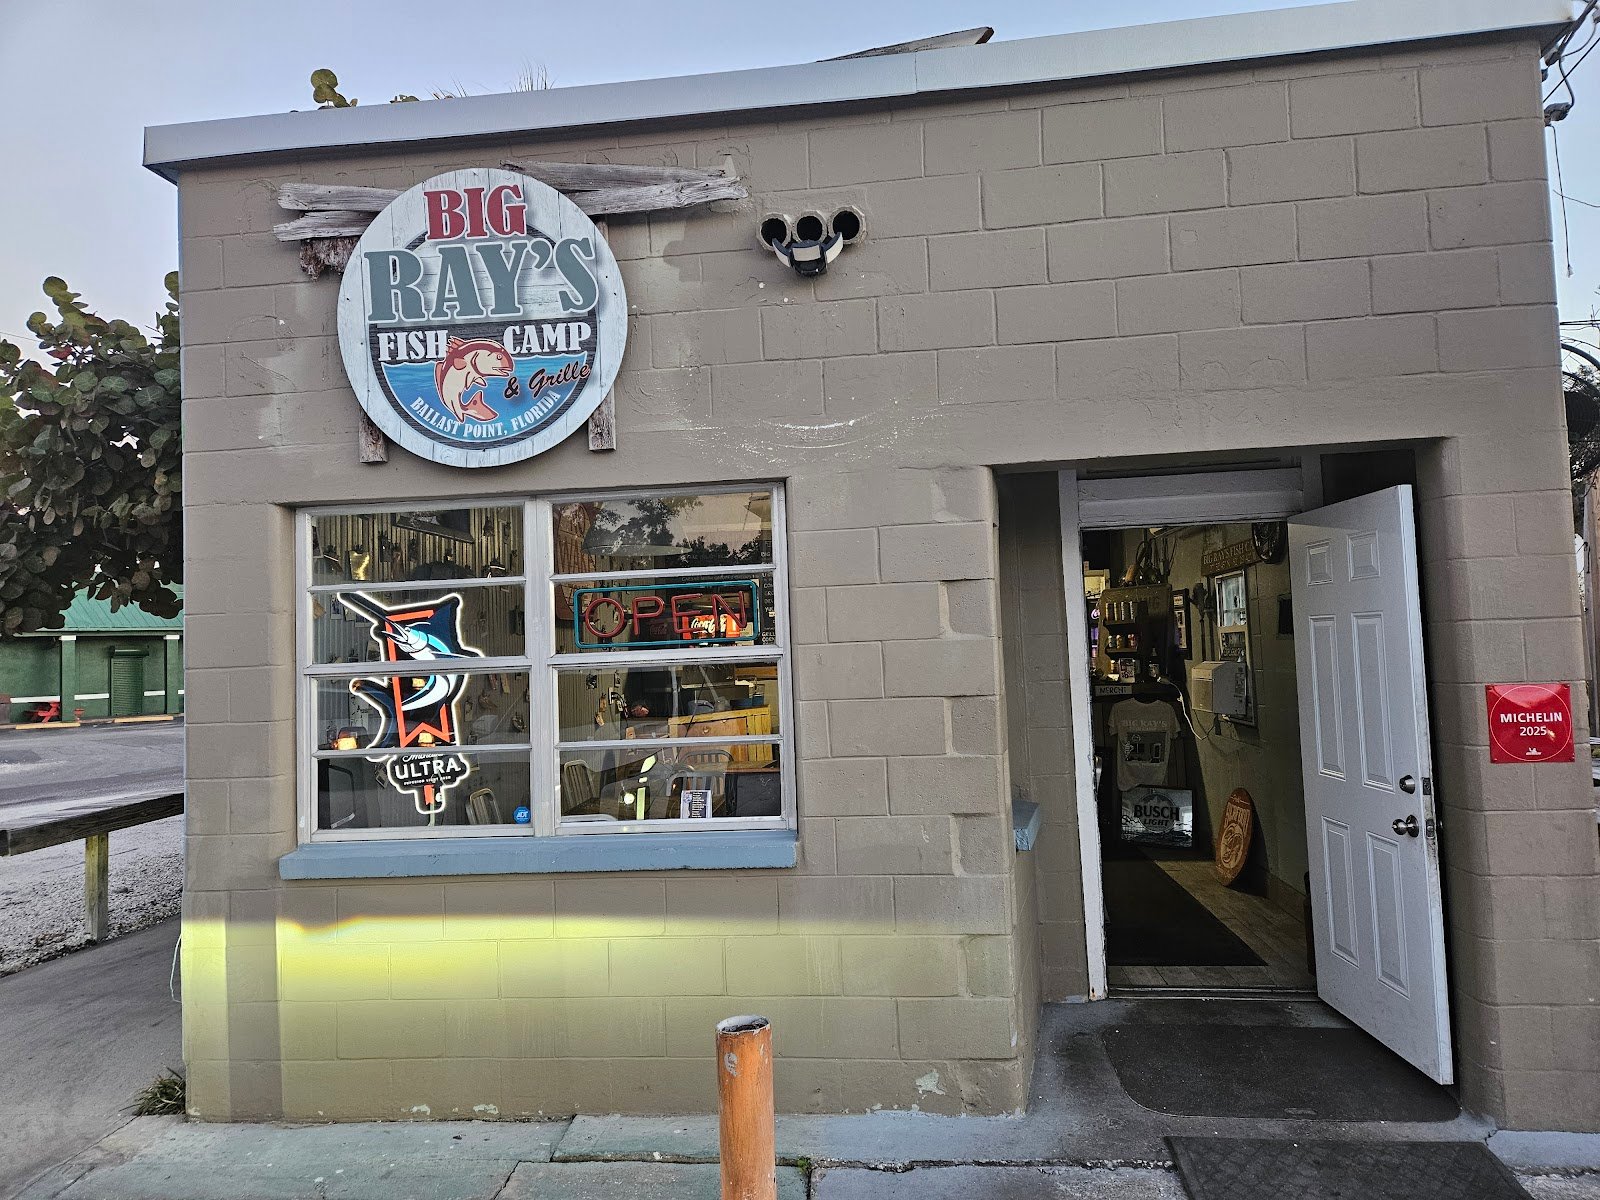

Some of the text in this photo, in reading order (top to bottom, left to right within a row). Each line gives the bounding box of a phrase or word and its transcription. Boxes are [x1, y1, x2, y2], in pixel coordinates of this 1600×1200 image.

[423, 185, 527, 240] BIG
[364, 237, 598, 323] RAY'S
[377, 322, 591, 361] FISH CAMP
[504, 361, 590, 399] & Grille
[410, 390, 561, 438] BALLAST POINT, FLORIDA
[585, 591, 747, 637] OPEN
[1500, 712, 1563, 723] MICHELIN
[1519, 726, 1547, 736] 2025
[395, 757, 461, 779] ULTRA
[1134, 804, 1180, 821] BUSCH
